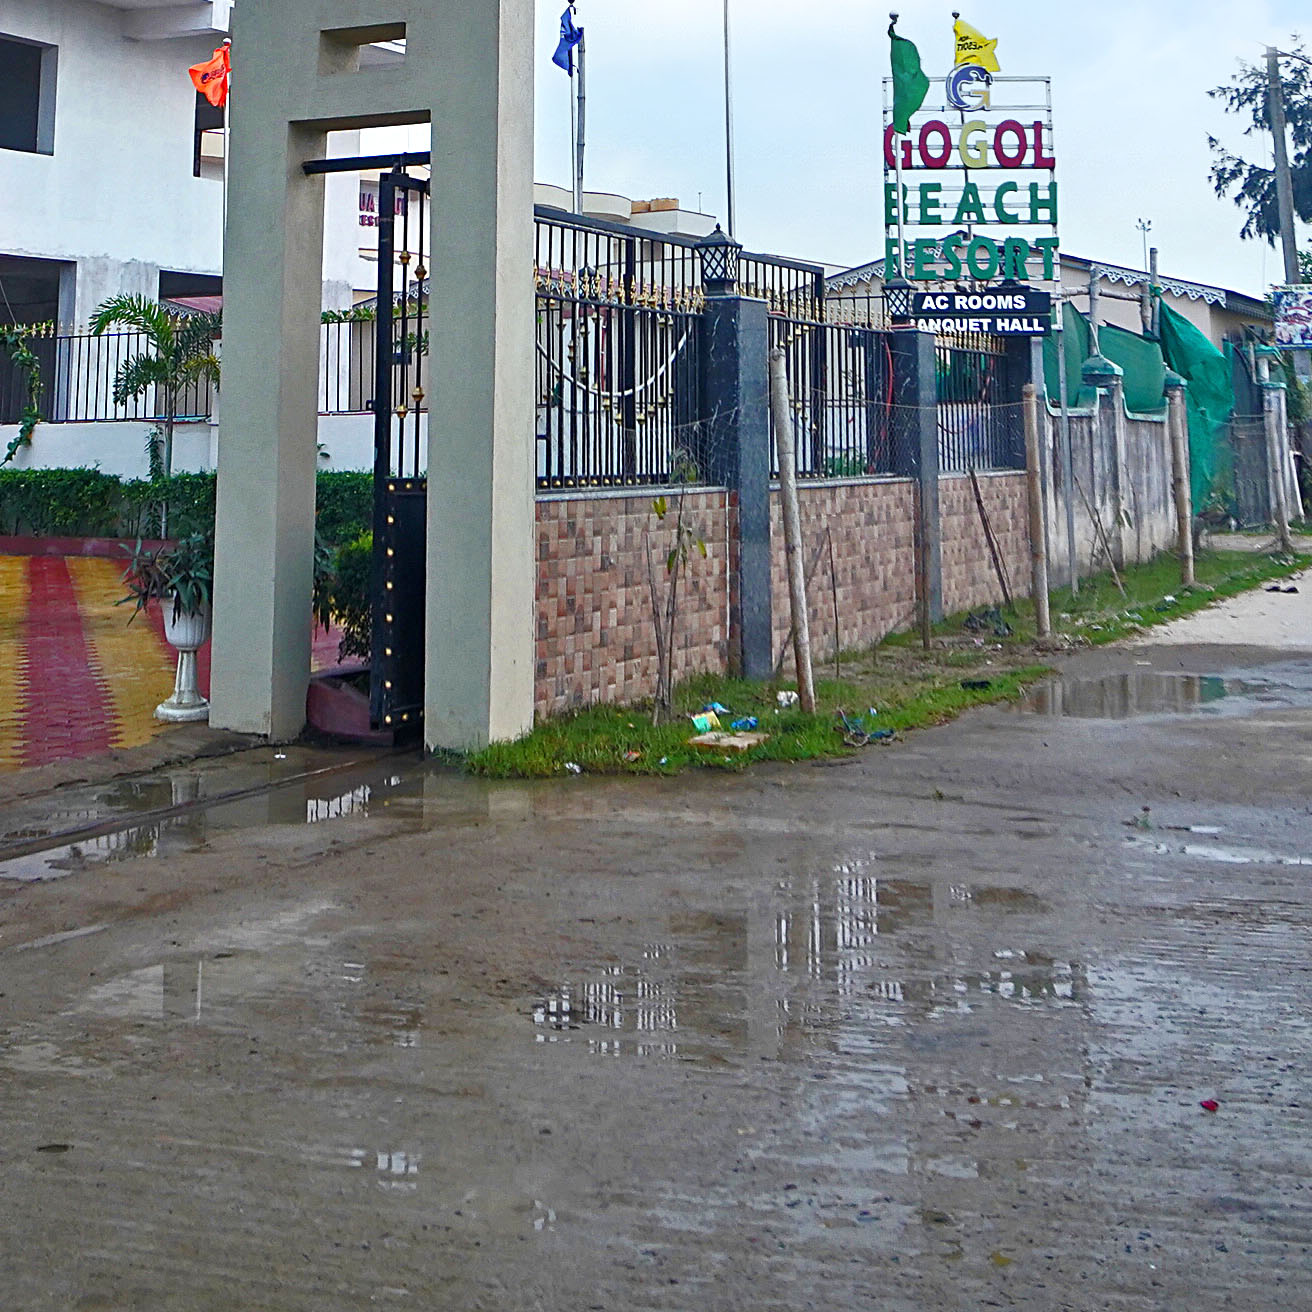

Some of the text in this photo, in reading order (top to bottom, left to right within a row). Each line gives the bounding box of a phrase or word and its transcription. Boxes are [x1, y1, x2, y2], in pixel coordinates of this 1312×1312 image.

[884, 120, 1055, 168] GOGOL
[885, 181, 1058, 224] BEACH
[886, 236, 1059, 281] RESORT
[921, 294, 1026, 310] AC ROOMS
[996, 318, 1045, 331] HALL
